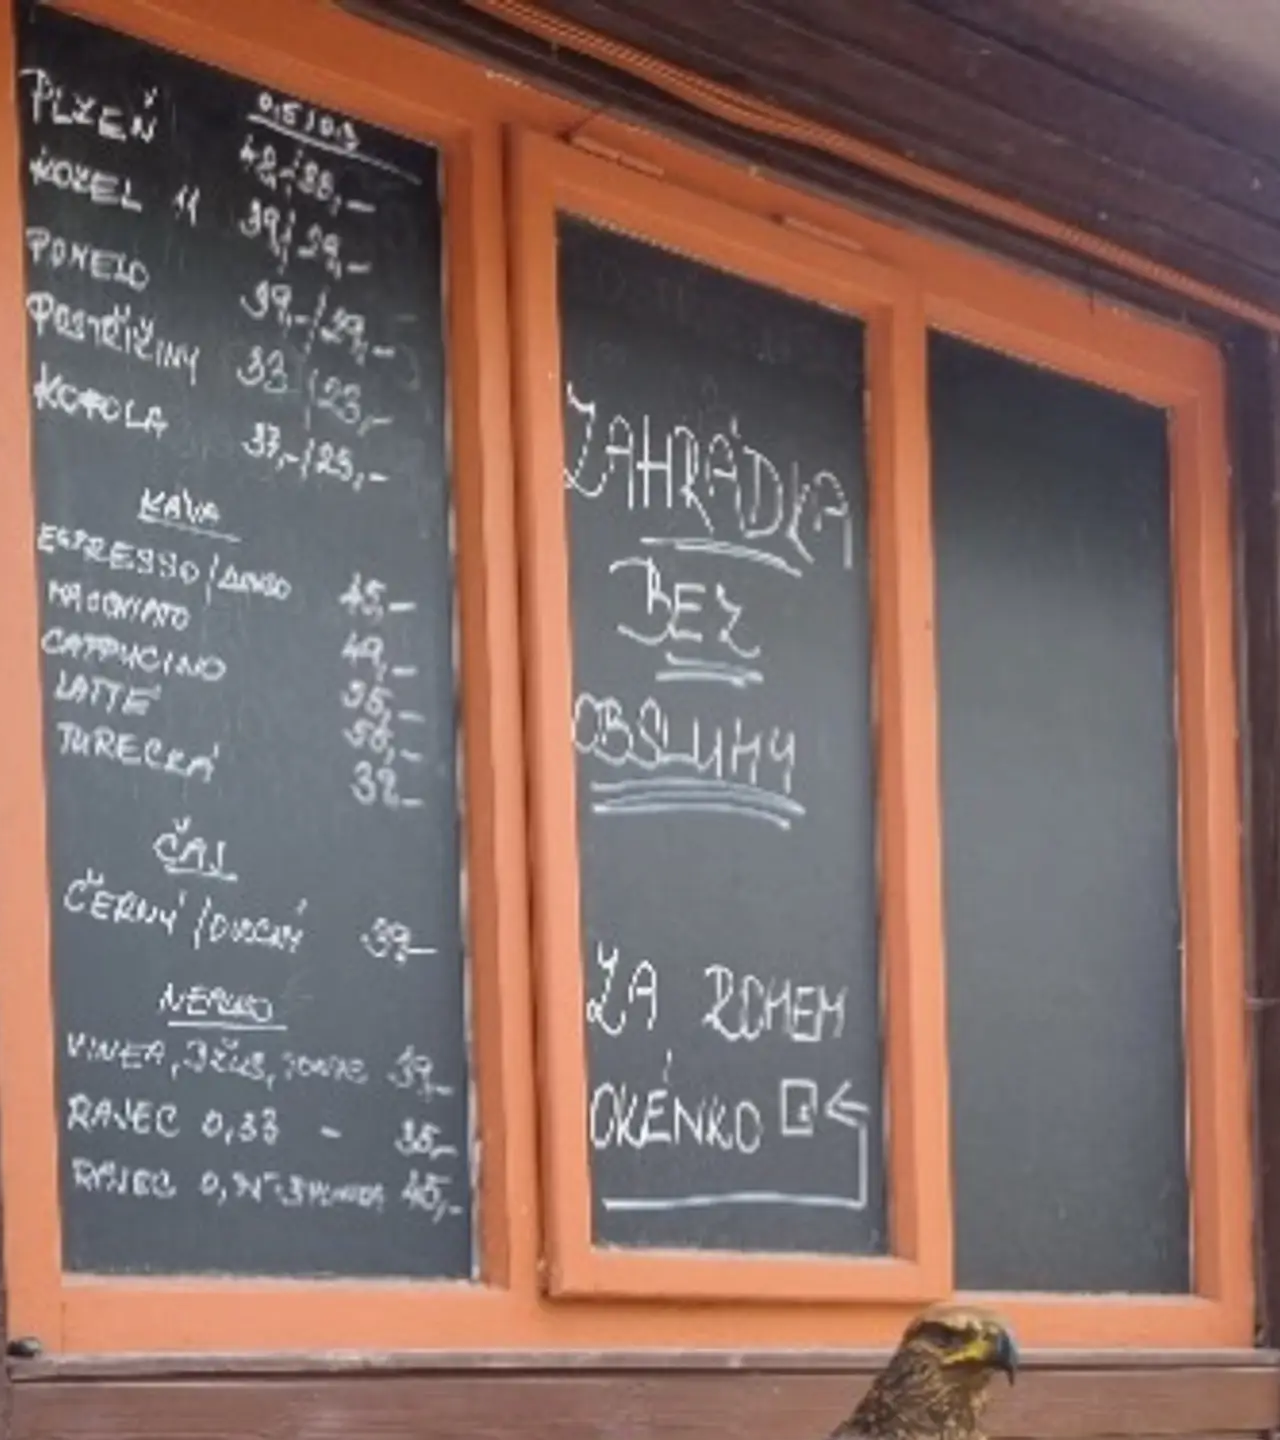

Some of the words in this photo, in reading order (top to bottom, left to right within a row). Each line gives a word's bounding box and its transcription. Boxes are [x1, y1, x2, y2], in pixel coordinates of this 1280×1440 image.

[30, 146, 142, 212] KOZEL
[609, 556, 762, 659] BEZ
[54, 669, 163, 715] LATTE
[586, 941, 658, 1038] ZA
[589, 1048, 764, 1155] OKÉNKO
